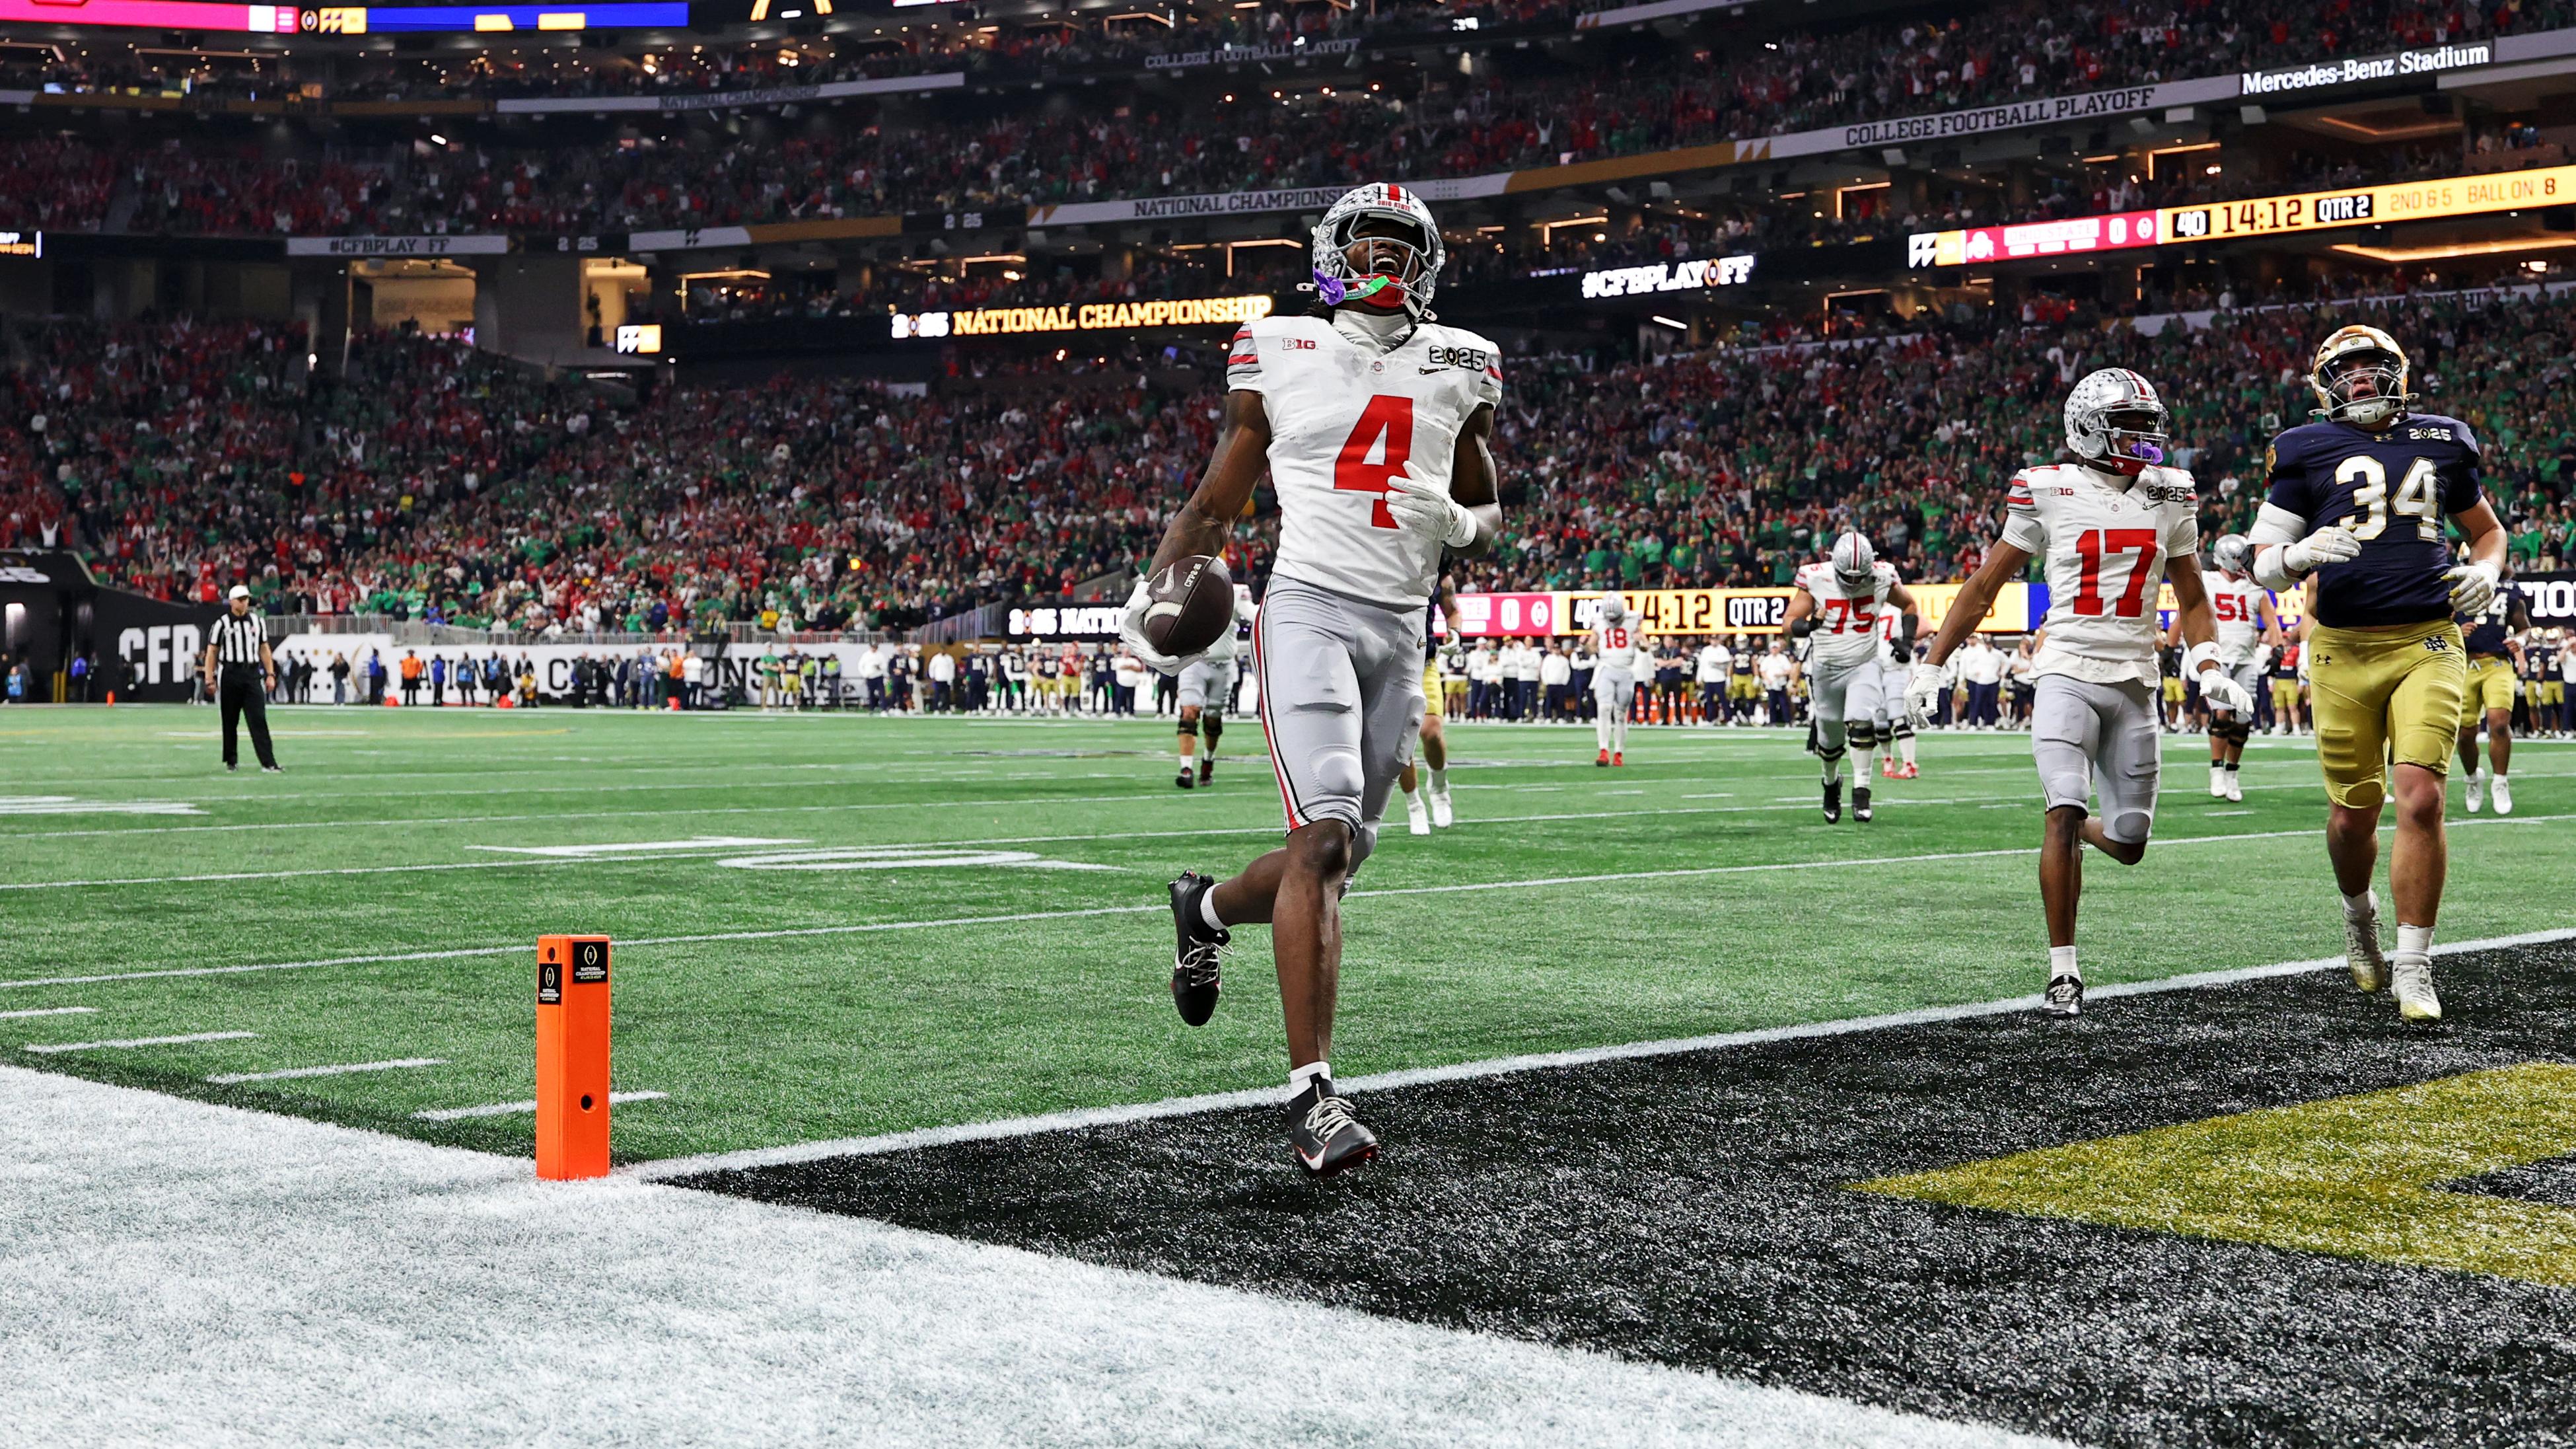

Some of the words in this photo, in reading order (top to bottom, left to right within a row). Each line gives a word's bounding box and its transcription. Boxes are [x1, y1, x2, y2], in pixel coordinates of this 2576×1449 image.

[1145, 52, 1209, 68] COLLEGE
[1214, 46, 1288, 63] FOOTBALL
[1293, 38, 1361, 55] PLAYOFF
[2242, 58, 2394, 94] Mercedes-Benz
[2399, 46, 2489, 74] Stadium
[1846, 118, 1935, 146] COLLEGE
[1940, 103, 2050, 134] FOOTBALL
[2056, 87, 2155, 118] PLAYOFF
[1133, 196, 1224, 217] NATIONAL
[1227, 189, 1352, 210] CHAMPIONSH
[2390, 192, 2421, 212] 2ND
[2443, 188, 2452, 207] 5
[2468, 183, 2506, 204] BALL
[2511, 180, 2534, 200] ON
[2545, 178, 2556, 196] 8
[2048, 223, 2093, 239] STATE
[2177, 210, 2207, 237] 40
[2223, 199, 2302, 233] 14:12
[2318, 197, 2354, 223] QTR
[2356, 194, 2370, 217] 2
[330, 239, 449, 253] #CFBPLAYFF
[952, 306, 1077, 335] NATIONAL
[1079, 295, 1272, 329] CHAMPIONSHIP
[1429, 345, 1486, 372] 2025
[2409, 428, 2452, 441] 2025
[1334, 394, 1413, 529] 4
[2147, 486, 2188, 502] 2025
[2334, 455, 2439, 542] 34
[2073, 529, 2158, 618] 17
[1059, 607, 1122, 634] NATIO
[1729, 597, 1768, 628] QTR
[1770, 597, 1785, 626] 2
[1825, 595, 1875, 634] 75
[2215, 593, 2250, 622] 51
[119, 624, 201, 685] CFP
[1605, 628, 1628, 650] 18
